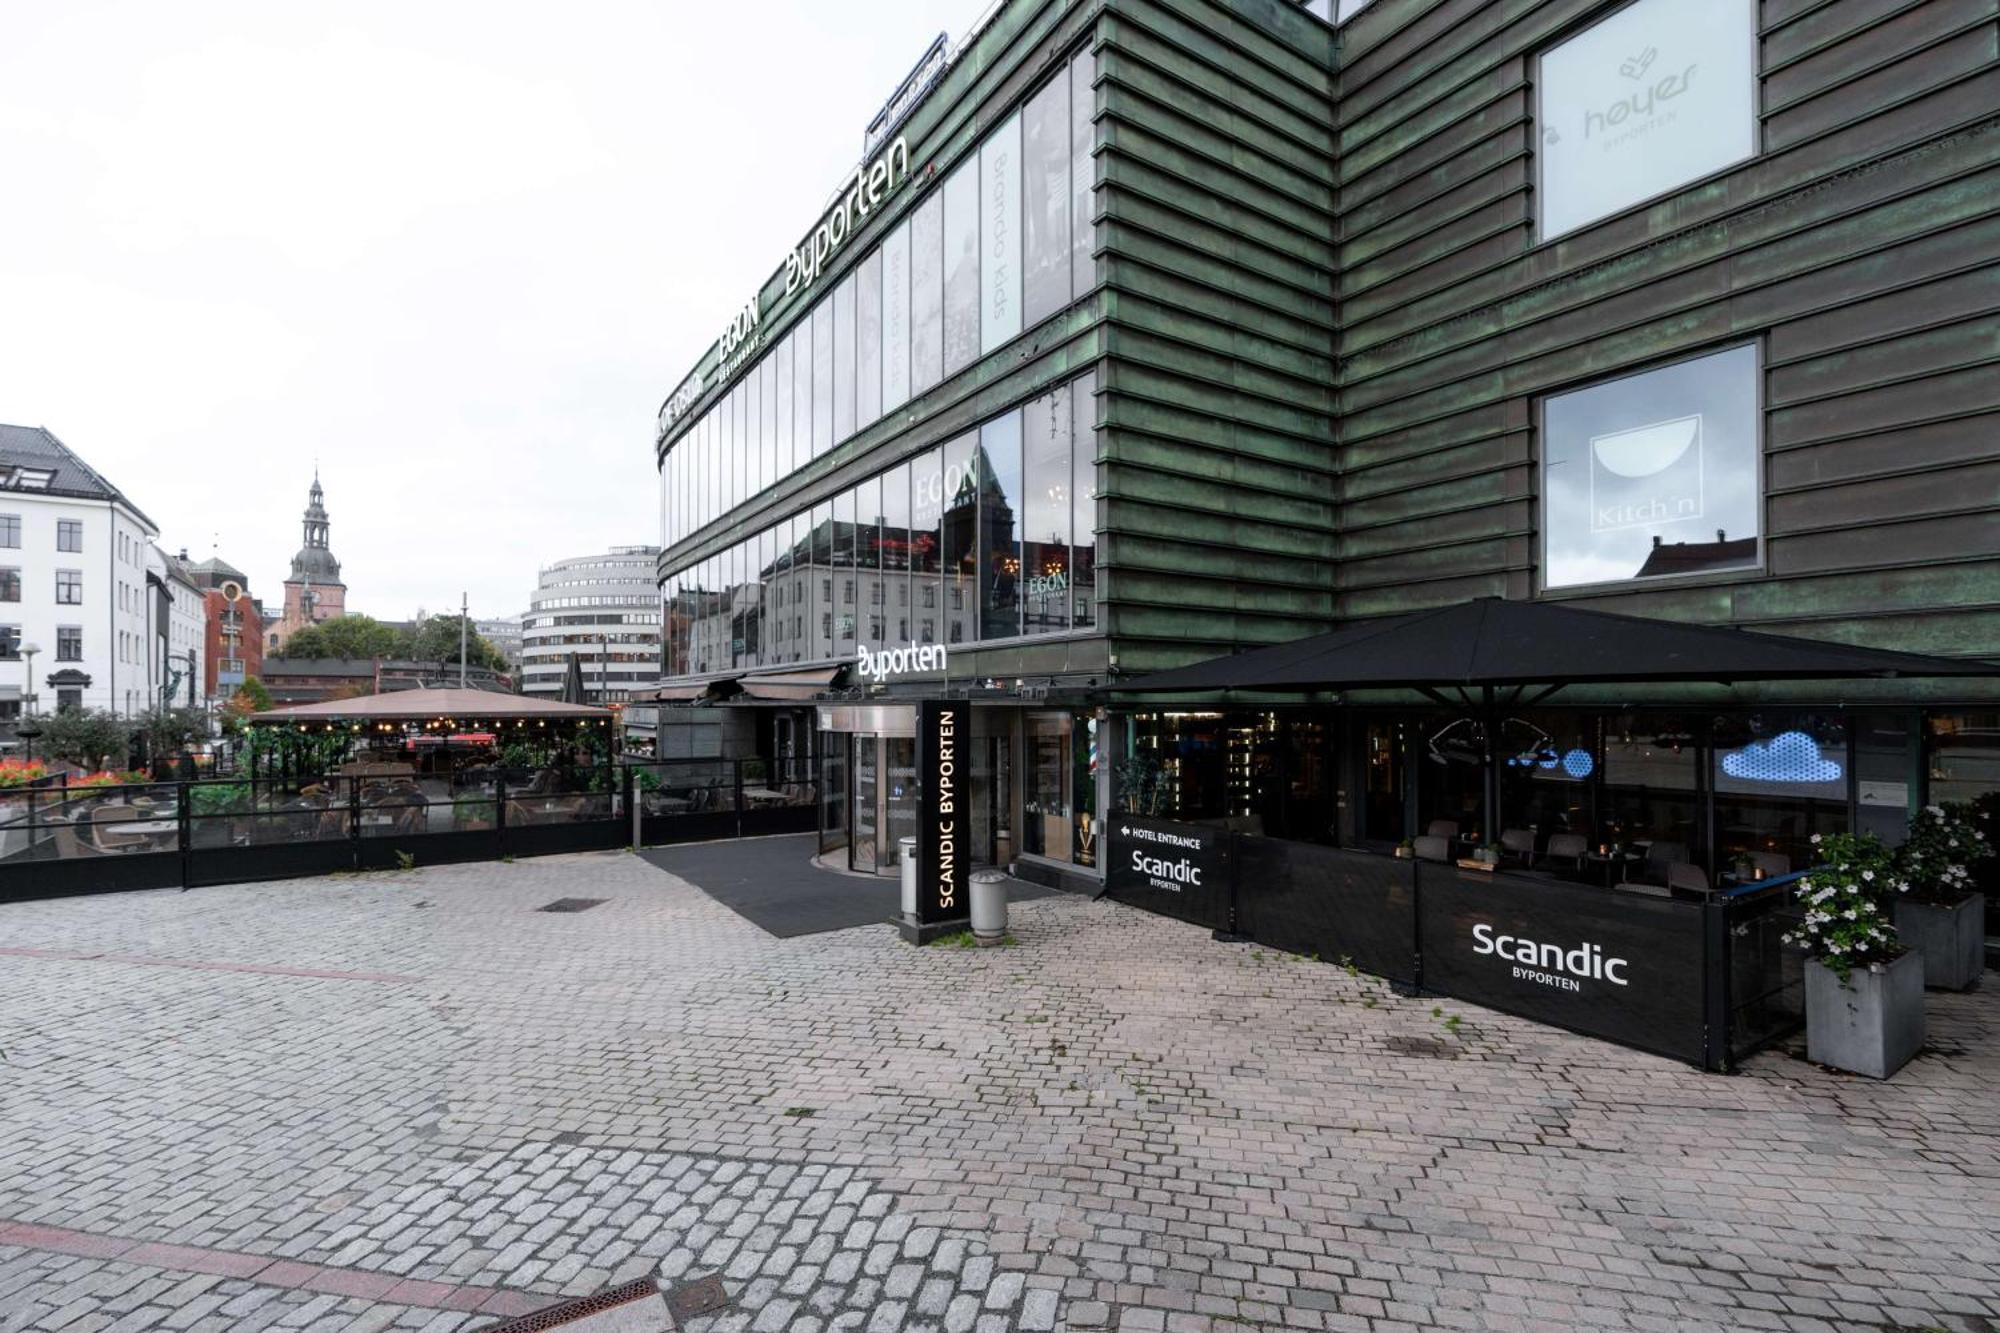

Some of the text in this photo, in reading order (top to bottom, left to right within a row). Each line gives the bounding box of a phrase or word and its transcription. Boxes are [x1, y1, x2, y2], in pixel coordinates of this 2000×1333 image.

[1585, 64, 1697, 139] høyer
[785, 135, 907, 296] Byporten
[719, 296, 760, 363] EGON
[916, 454, 979, 509] EGON
[1030, 572, 1067, 594] EGON
[858, 640, 946, 682] Byporten
[940, 711, 954, 908] SCANDIC BYPORTEN
[1132, 827, 1201, 850] HOTEL ENTRANCE
[1132, 850, 1201, 886] Scandic
[1150, 878, 1181, 892] BYPORTEN
[1472, 923, 1628, 986] Scandic
[1512, 966, 1580, 992] BYPORTEN
